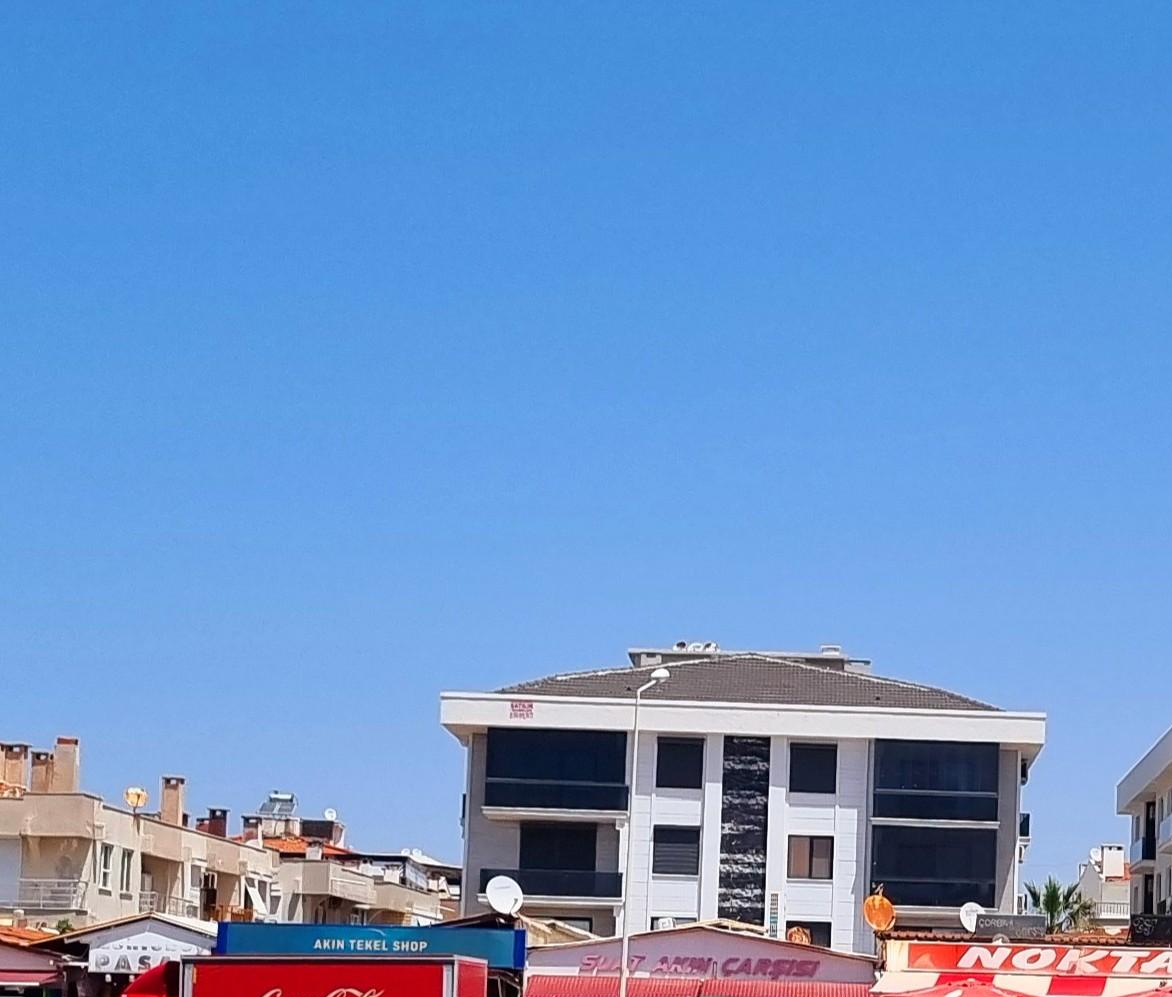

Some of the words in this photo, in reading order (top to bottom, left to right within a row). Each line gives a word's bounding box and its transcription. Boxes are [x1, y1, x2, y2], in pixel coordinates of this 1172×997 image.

[313, 938, 345, 951] AKIN
[348, 939, 389, 952] TEKEL
[392, 940, 428, 953] SHOP
